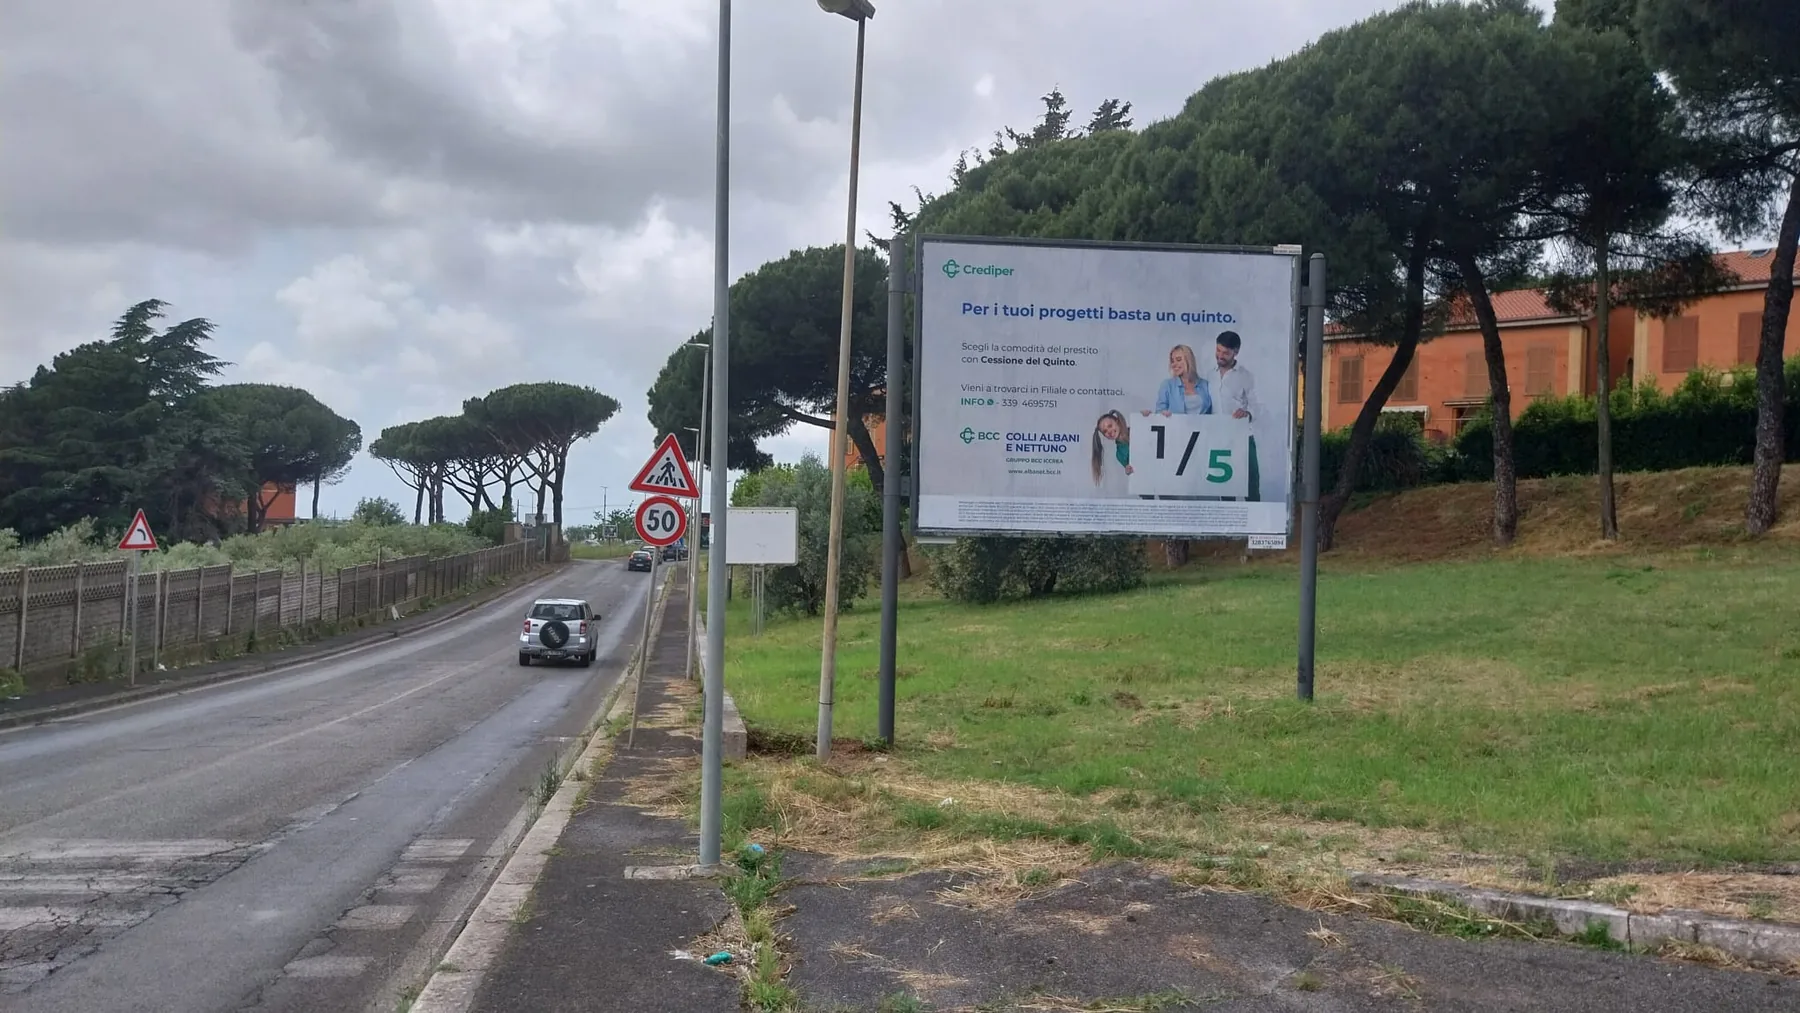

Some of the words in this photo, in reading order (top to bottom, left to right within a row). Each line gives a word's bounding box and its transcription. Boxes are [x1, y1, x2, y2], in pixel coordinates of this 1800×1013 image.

[963, 264, 1014, 278] Crediper
[962, 302, 989, 315] Per
[994, 303, 998, 316] i
[1002, 304, 1034, 317] tuoi
[1039, 306, 1104, 321] progetti
[1108, 308, 1150, 322] basta
[1156, 311, 1176, 322] un
[1180, 310, 1236, 325] quinto.
[962, 342, 989, 353] Scegli
[992, 343, 999, 352] la
[1001, 344, 1045, 353] comodità
[1047, 345, 1061, 354] del
[1064, 346, 1098, 356] prestito
[980, 356, 1023, 365] Cessione
[1026, 358, 1040, 366] del
[1043, 358, 1077, 366] Quinto.
[961, 384, 984, 392] Vieni
[994, 385, 1028, 394] trovarci
[1030, 385, 1039, 394] in
[1041, 386, 1067, 395] Filiale
[1078, 387, 1125, 396] contattaci.
[960, 398, 984, 406] INFO
[1022, 400, 1057, 408] 4695751
[978, 432, 1000, 440] BCC
[1006, 432, 1036, 441] COLLI
[1040, 434, 1080, 442] ALBANI
[1006, 444, 1012, 452] E
[1016, 444, 1066, 452] NETTUNO
[1151, 426, 1233, 484] 1/5
[646, 510, 676, 532] 50
